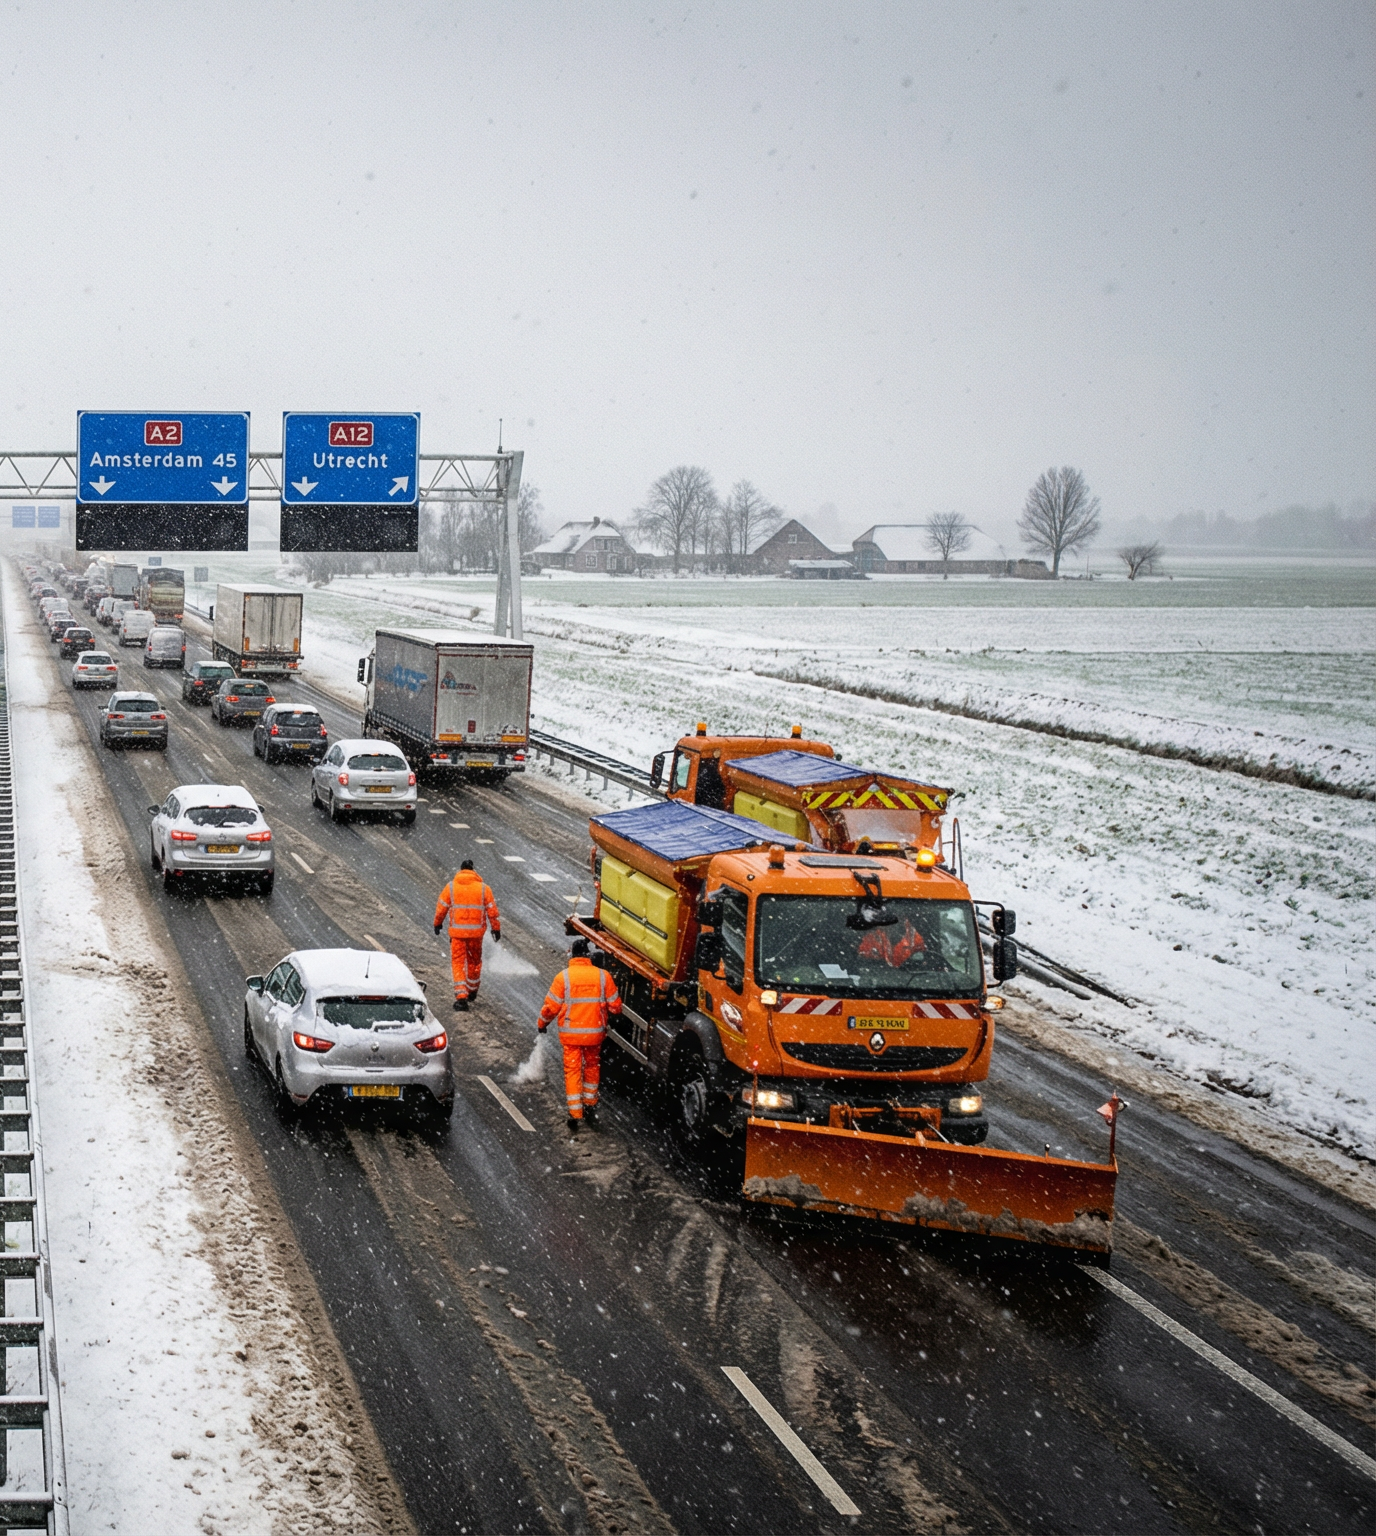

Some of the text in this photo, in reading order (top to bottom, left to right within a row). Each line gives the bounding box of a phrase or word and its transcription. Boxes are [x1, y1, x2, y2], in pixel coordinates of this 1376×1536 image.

[150, 425, 178, 441] A2
[333, 426, 369, 442] A12
[89, 451, 237, 468] Amsterdam 45
[313, 452, 388, 469] Utrecht
